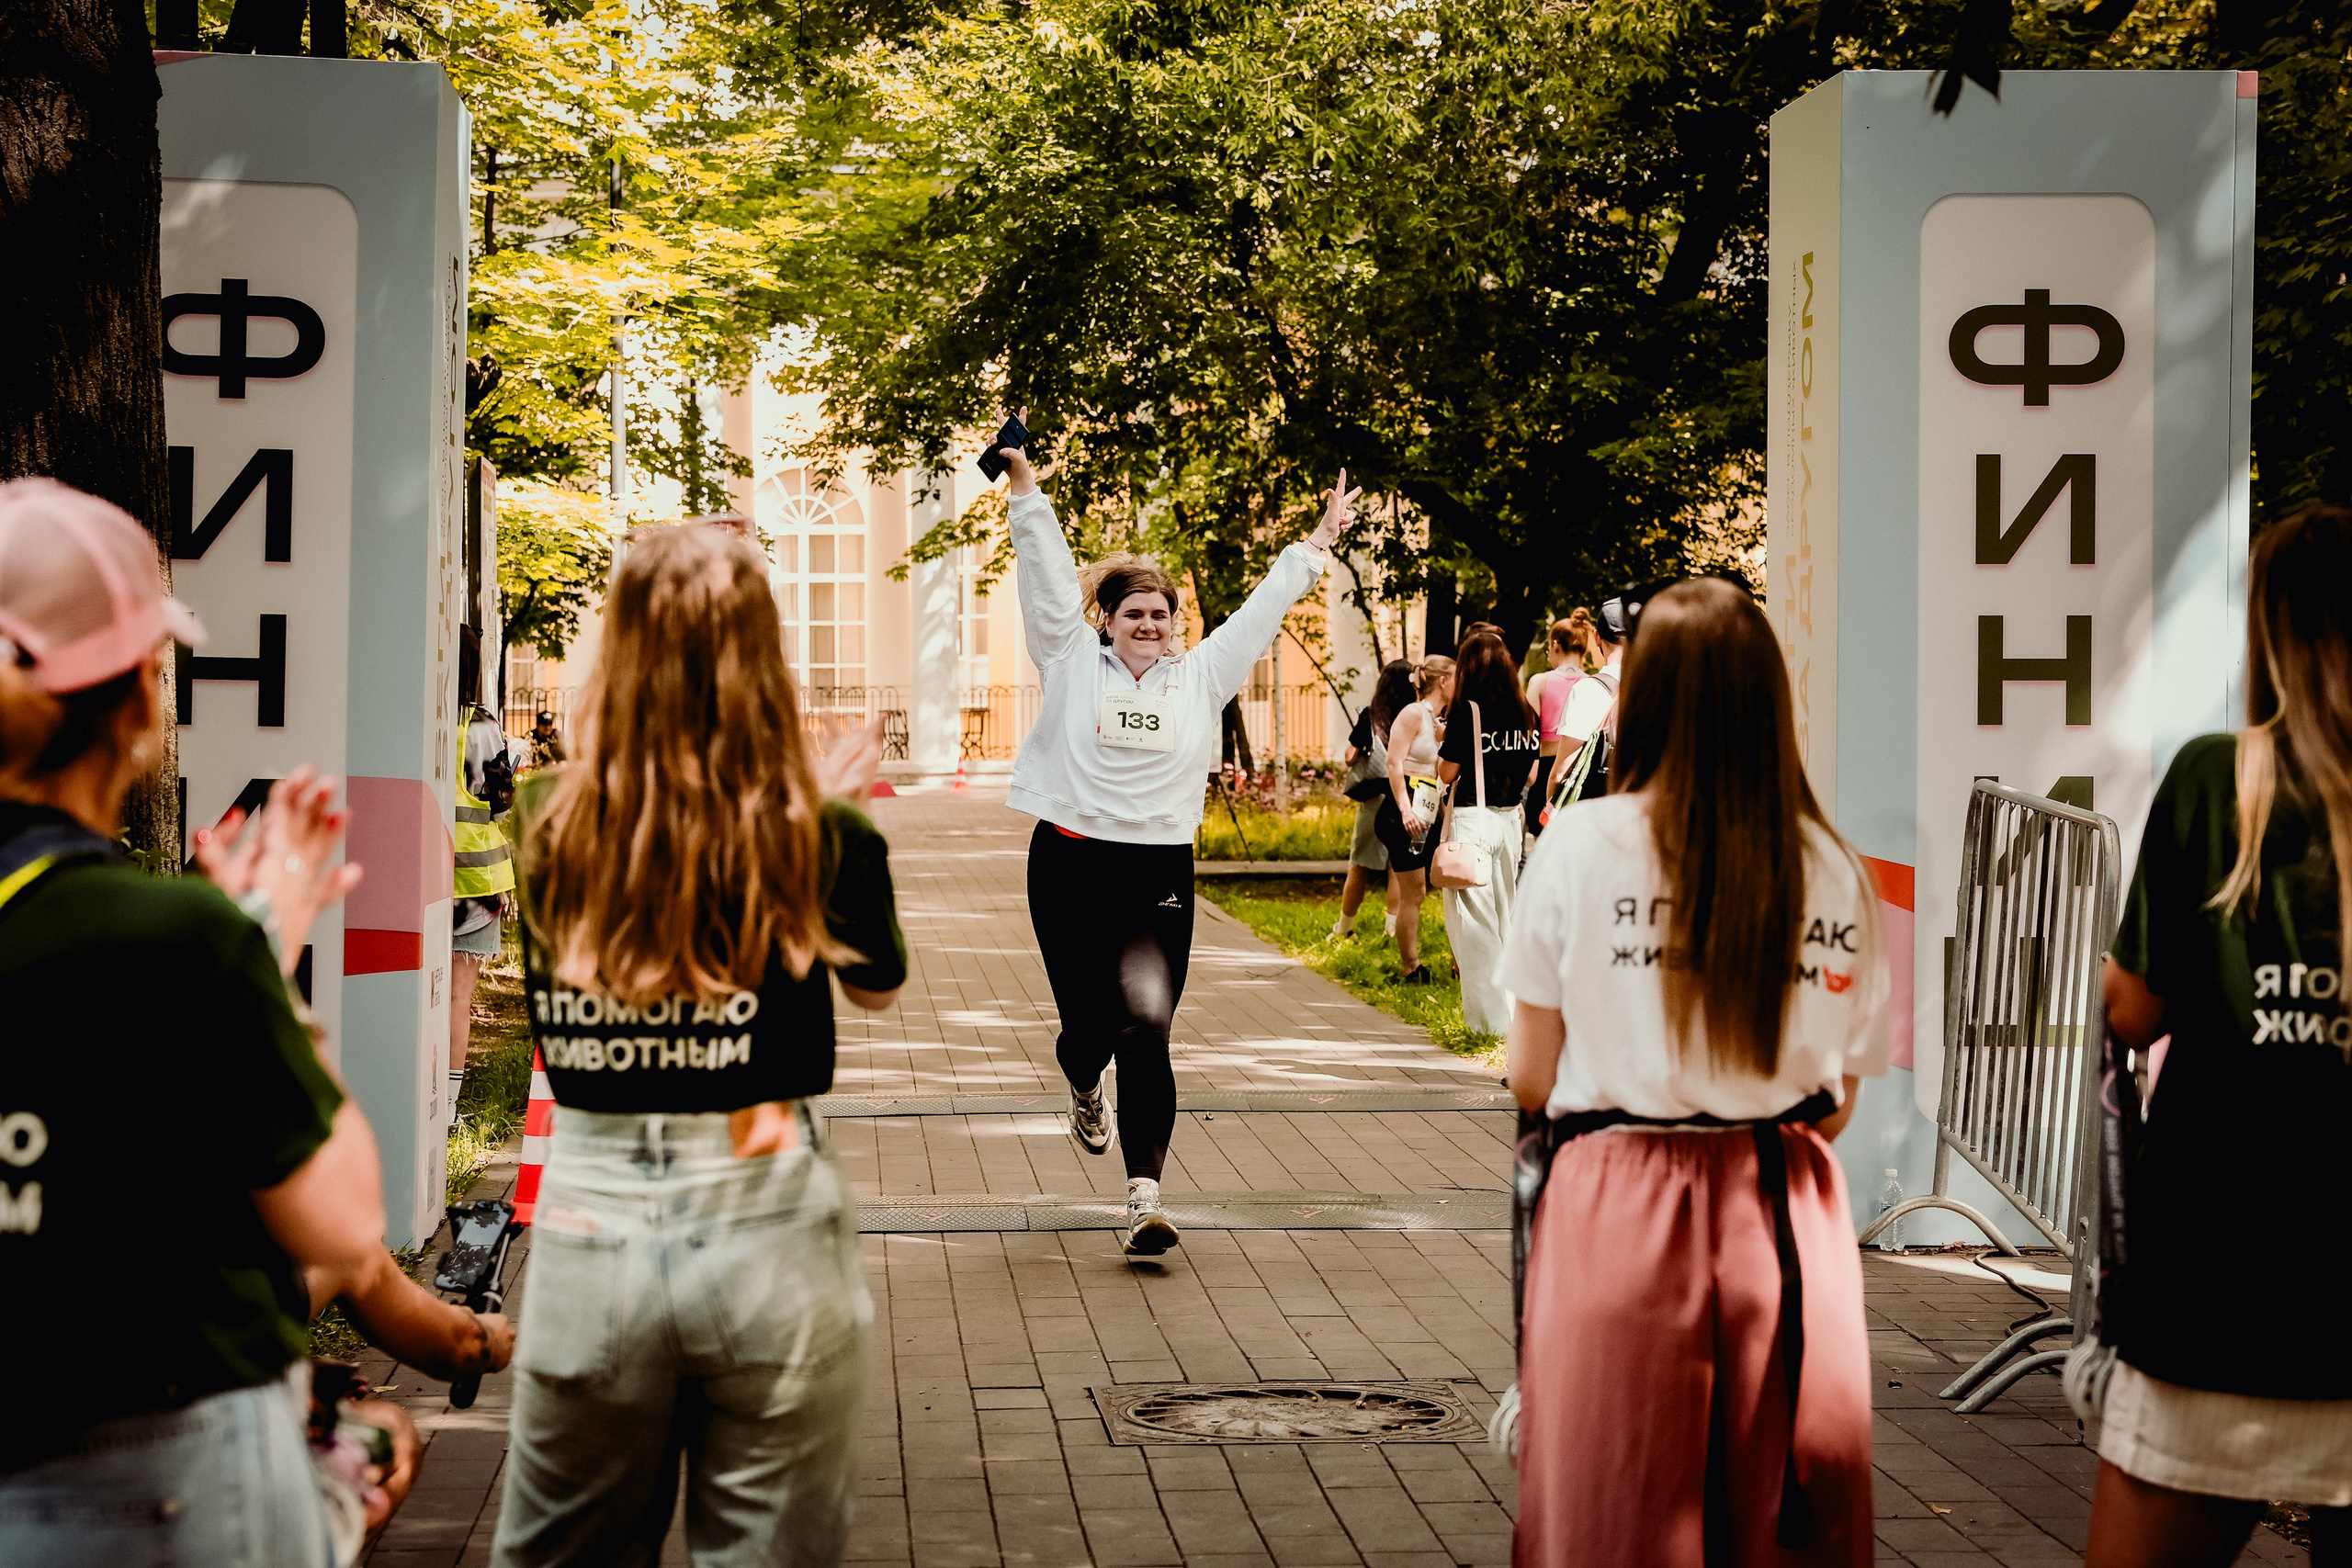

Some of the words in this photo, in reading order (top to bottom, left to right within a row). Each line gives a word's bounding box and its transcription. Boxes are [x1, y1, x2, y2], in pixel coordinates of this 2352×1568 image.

[1800, 251, 1814, 637] ДРУГОМ
[442, 664, 449, 782] ЗА
[446, 256, 458, 644] ДРУГОМ
[435, 555, 445, 781] БЕГИ
[1117, 711, 1160, 731] 133
[1799, 657, 1810, 771] ЗА
[1422, 798, 1436, 812] 149
[1614, 897, 1637, 926] Я
[2254, 963, 2282, 999] Я
[551, 990, 760, 1027] ПОМОГАЮ
